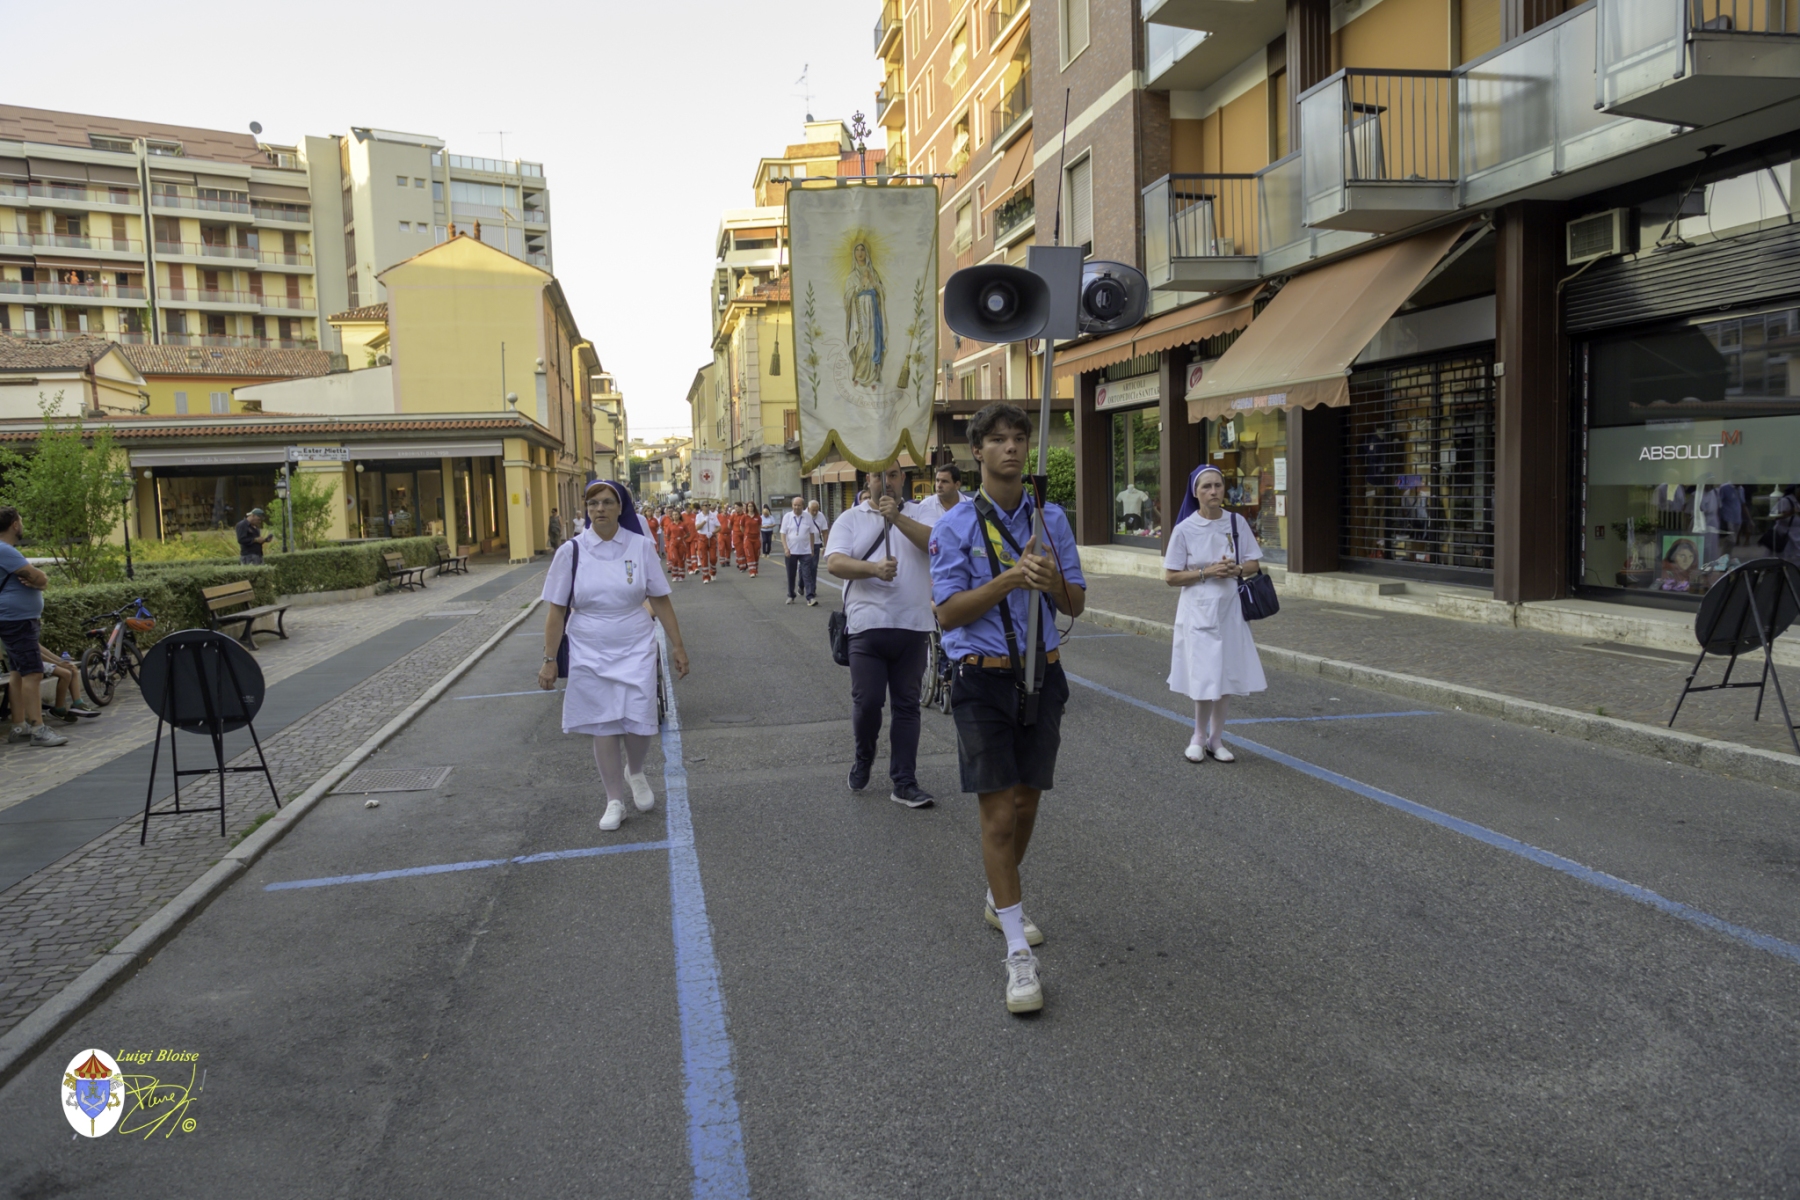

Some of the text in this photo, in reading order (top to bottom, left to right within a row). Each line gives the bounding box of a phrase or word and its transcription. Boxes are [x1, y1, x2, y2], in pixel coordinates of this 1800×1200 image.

[1122, 379, 1146, 391] ARTICOLI
[1107, 391, 1136, 404] ORTOPEDICI
[1639, 443, 1724, 461] ABSOLUT
